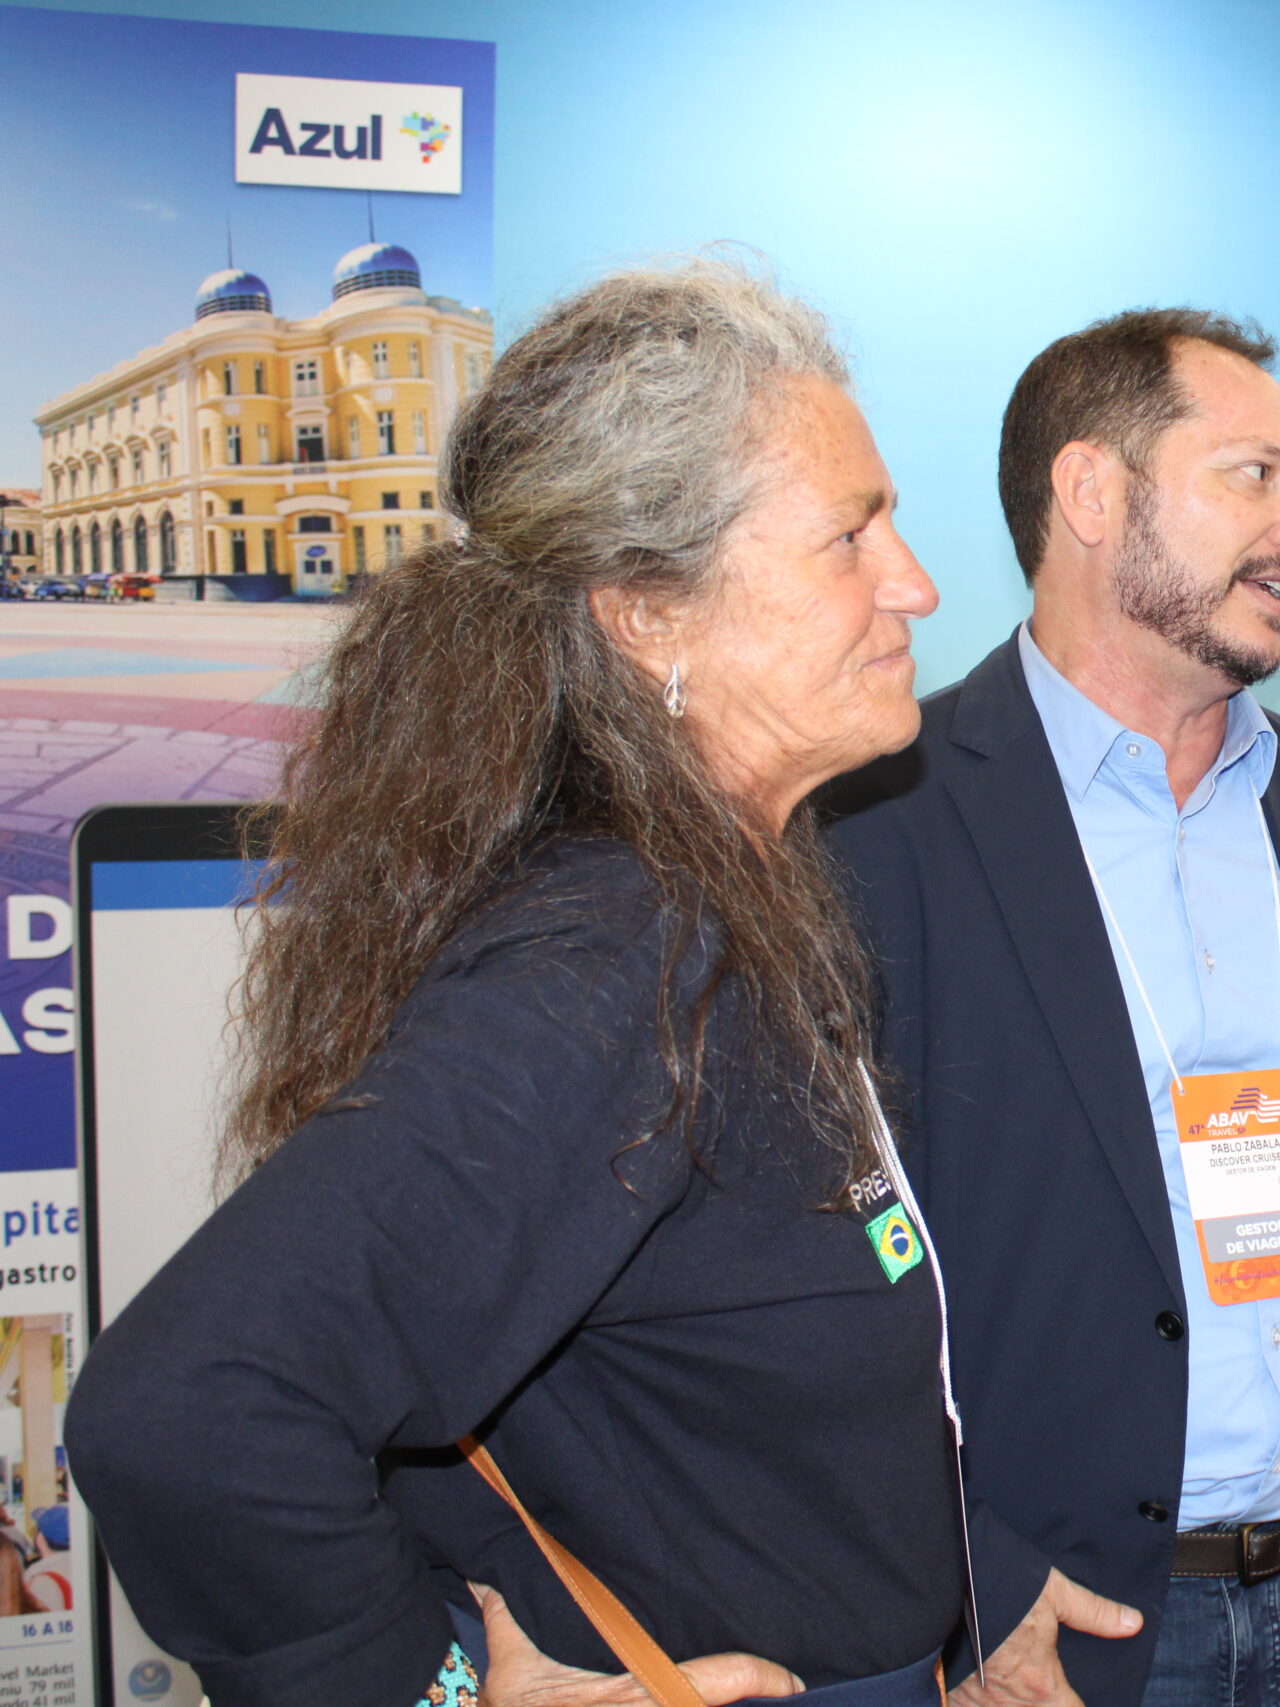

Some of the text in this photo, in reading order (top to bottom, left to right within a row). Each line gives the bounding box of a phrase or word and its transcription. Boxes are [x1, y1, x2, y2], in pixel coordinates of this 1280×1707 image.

[249, 107, 383, 161] Azul
[1206, 1110, 1250, 1129] ABAV
[1208, 1127, 1238, 1137] TRAVEL
[1211, 1138, 1280, 1154] PABLO ZABALA
[1210, 1155, 1251, 1168] DISCOVER
[1226, 1241, 1245, 1254] DE
[22, 1619, 74, 1637] 16 A 18
[26, 1662, 74, 1677] Market
[29, 1680, 47, 1693] 79
[53, 1677, 75, 1690] mil
[54, 1691, 75, 1705] mil
